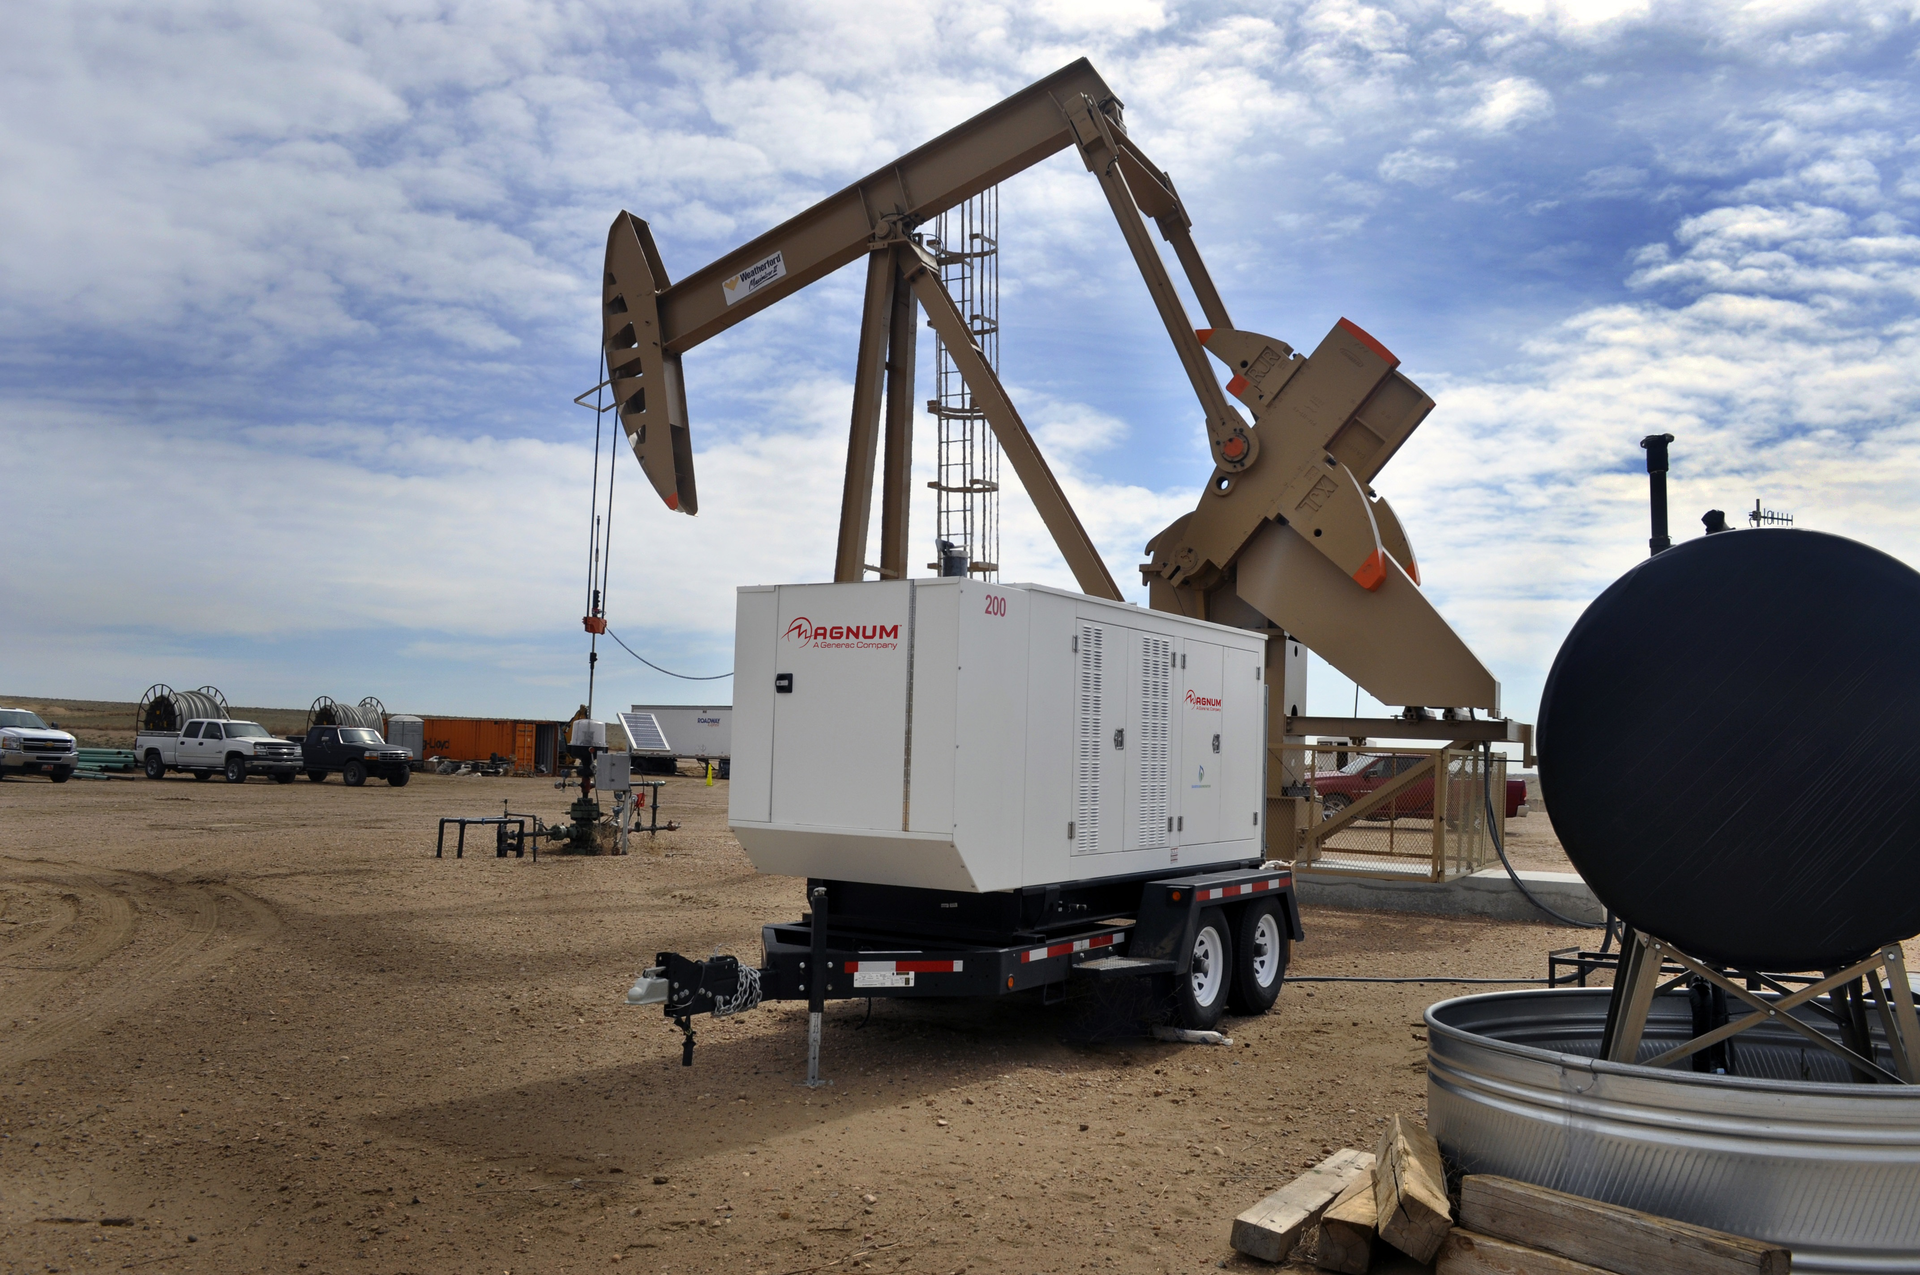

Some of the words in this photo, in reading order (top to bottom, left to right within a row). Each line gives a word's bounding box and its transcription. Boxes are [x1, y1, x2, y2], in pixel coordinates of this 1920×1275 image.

[740, 254, 781, 282] Weatherford
[1247, 351, 1281, 384] RJR
[985, 594, 1006, 617] 200
[856, 641, 898, 650] Company
